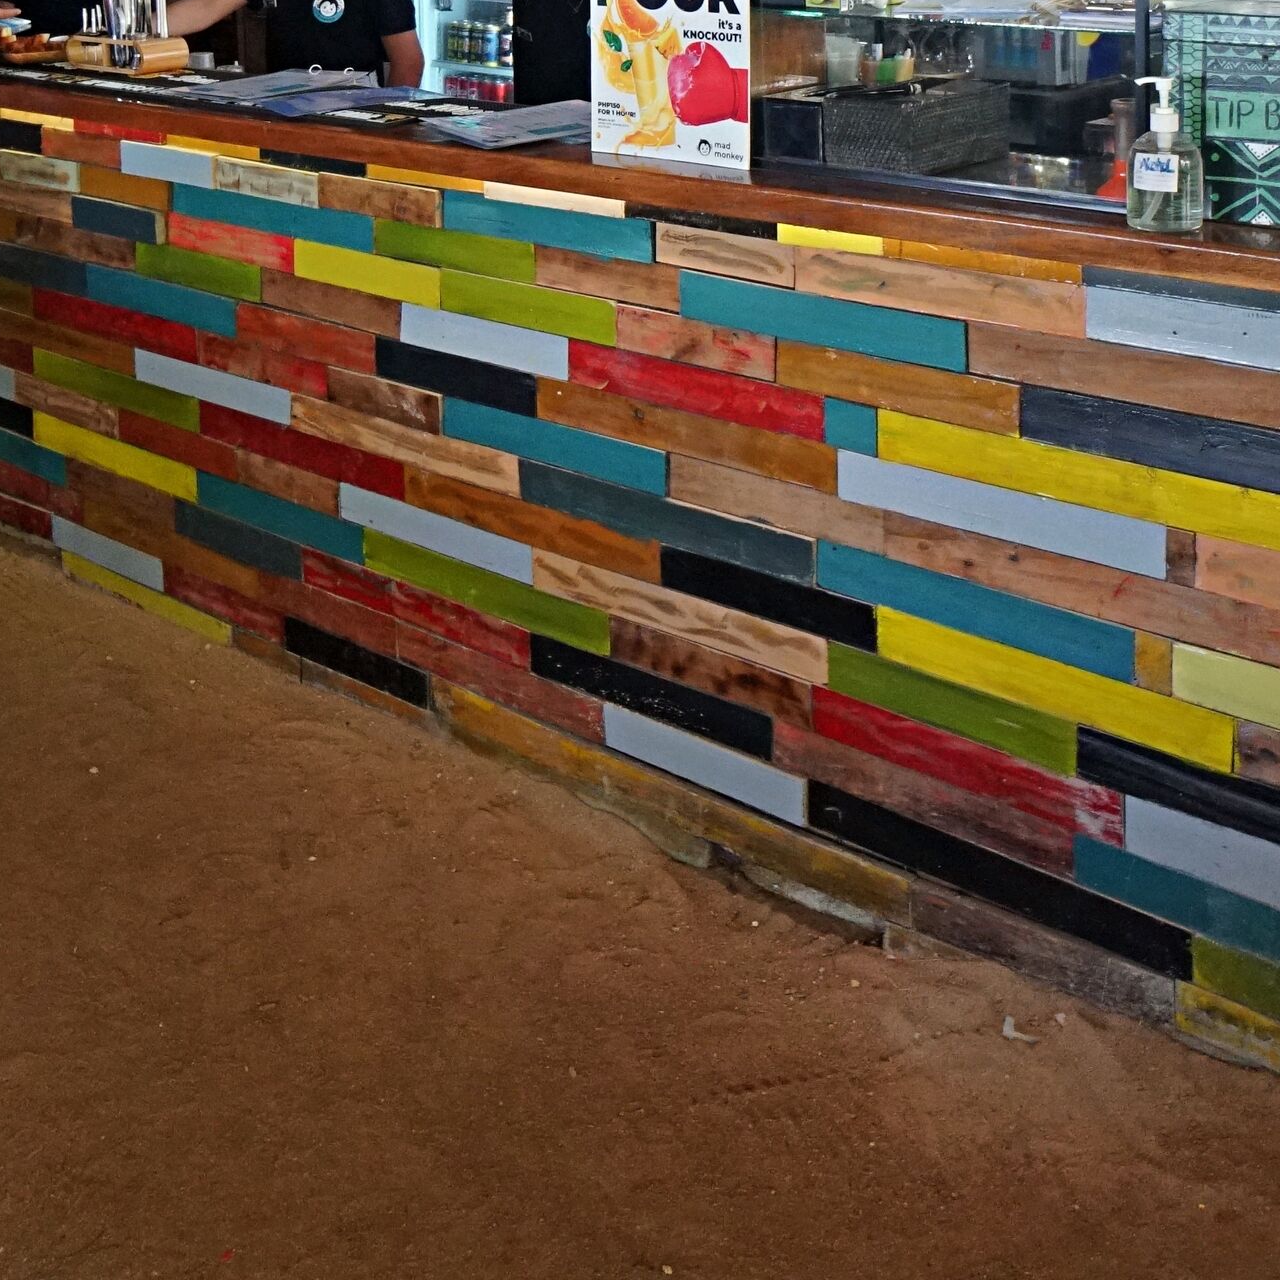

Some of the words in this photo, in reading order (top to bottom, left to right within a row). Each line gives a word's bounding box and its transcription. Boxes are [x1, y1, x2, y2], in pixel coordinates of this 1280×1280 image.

[718, 19, 733, 30] it's
[683, 30, 742, 43] KNOCKOUT!
[597, 101, 621, 109] PHP150
[1208, 96, 1255, 131] TIP
[714, 141, 731, 150] mad
[714, 151, 744, 163] monkey
